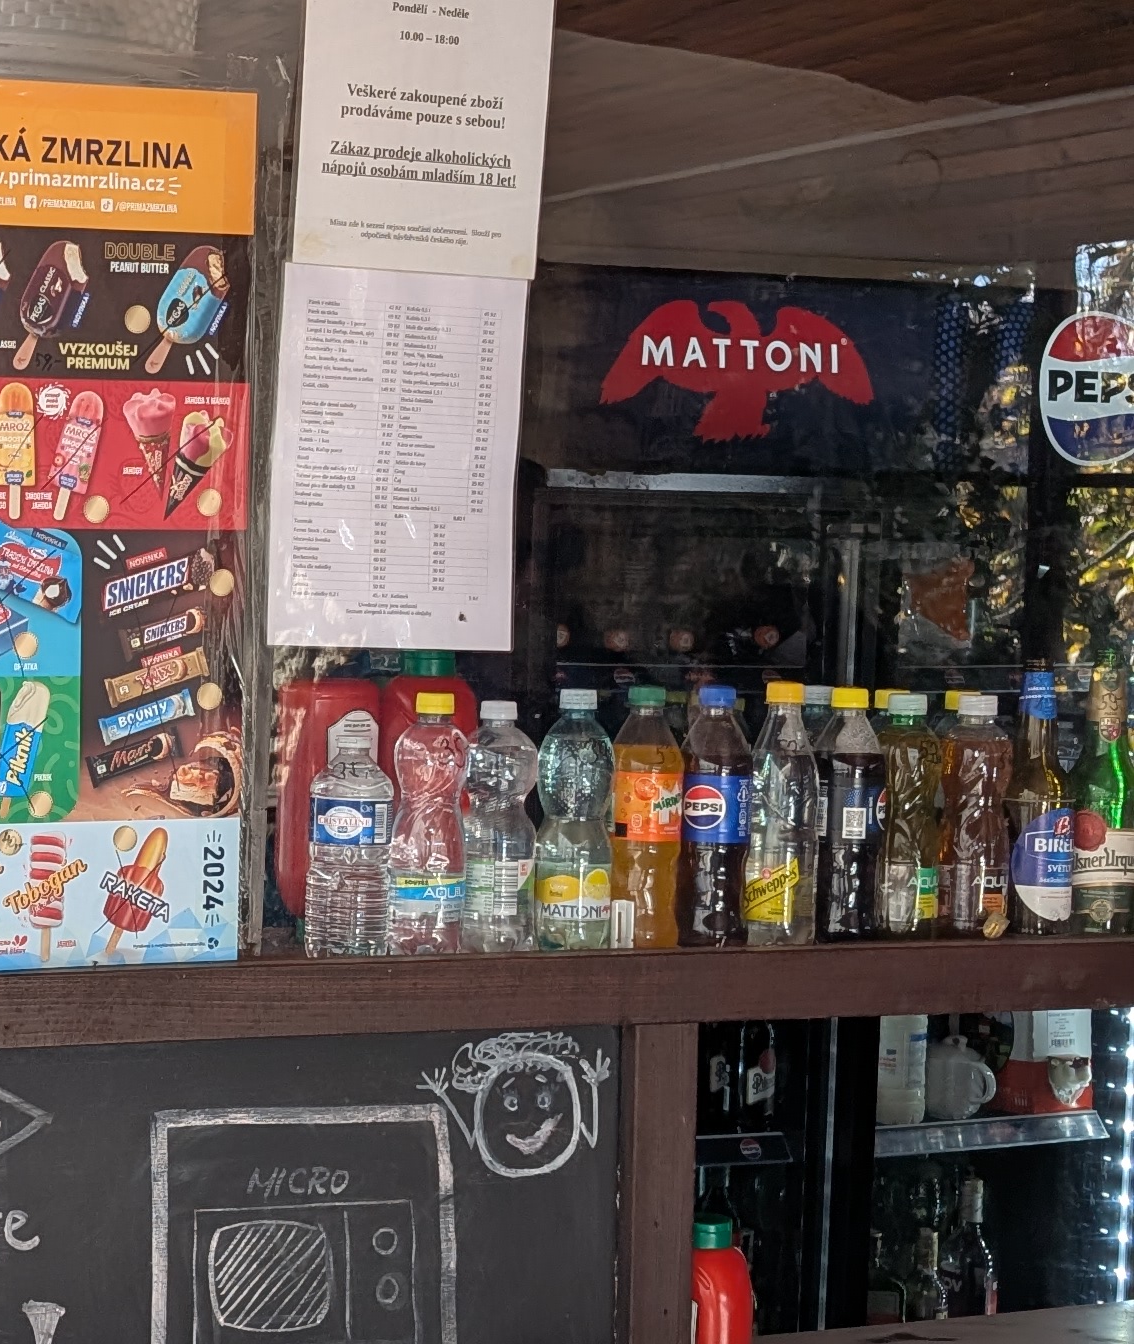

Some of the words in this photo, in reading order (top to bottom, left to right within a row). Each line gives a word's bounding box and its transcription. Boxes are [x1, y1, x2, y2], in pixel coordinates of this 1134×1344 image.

[392, 0, 428, 16] Pondělí
[438, 5, 471, 20] Neděle
[399, 30, 424, 43] 10.00
[434, 32, 461, 46] 18:00
[347, 82, 397, 100] Veškeré
[399, 89, 468, 109] zakoupené
[470, 93, 504, 111] zboží
[340, 103, 414, 123] prodáváme
[416, 110, 453, 126] pouze
[456, 115, 462, 125] s
[465, 113, 506, 130] sebou!
[41, 136, 194, 171] ZMRZLINA
[329, 140, 371, 159] Zákaz
[373, 143, 422, 163] prodeje
[424, 147, 512, 170] alkoholických
[321, 160, 368, 179] nápojů
[370, 162, 419, 181] osobám
[421, 166, 476, 185] mladším
[478, 171, 494, 186] 18
[496, 171, 517, 189] let!
[104, 241, 176, 263] DOUBLE
[110, 261, 140, 273] PEANUT
[141, 262, 170, 275] BUTTER
[59, 339, 138, 357] VYZKOUŠEJ
[640, 336, 840, 375] MATTONI
[66, 356, 130, 371] PREMIUM
[1047, 369, 1134, 404] PEP
[128, 550, 165, 569] NOVINKA
[106, 559, 189, 610] SNICKERS
[145, 616, 187, 642] SNICKERS
[117, 701, 168, 728] BOUNTY
[5, 727, 34, 787] Piknik
[683, 801, 723, 814] PEPSI
[3, 858, 88, 916] Tobogan
[202, 845, 226, 912] 2024
[743, 865, 798, 906] Schweppes
[99, 870, 170, 923] RAKETA
[540, 902, 604, 919] MATTONI
[247, 1166, 350, 1197] MICRO
